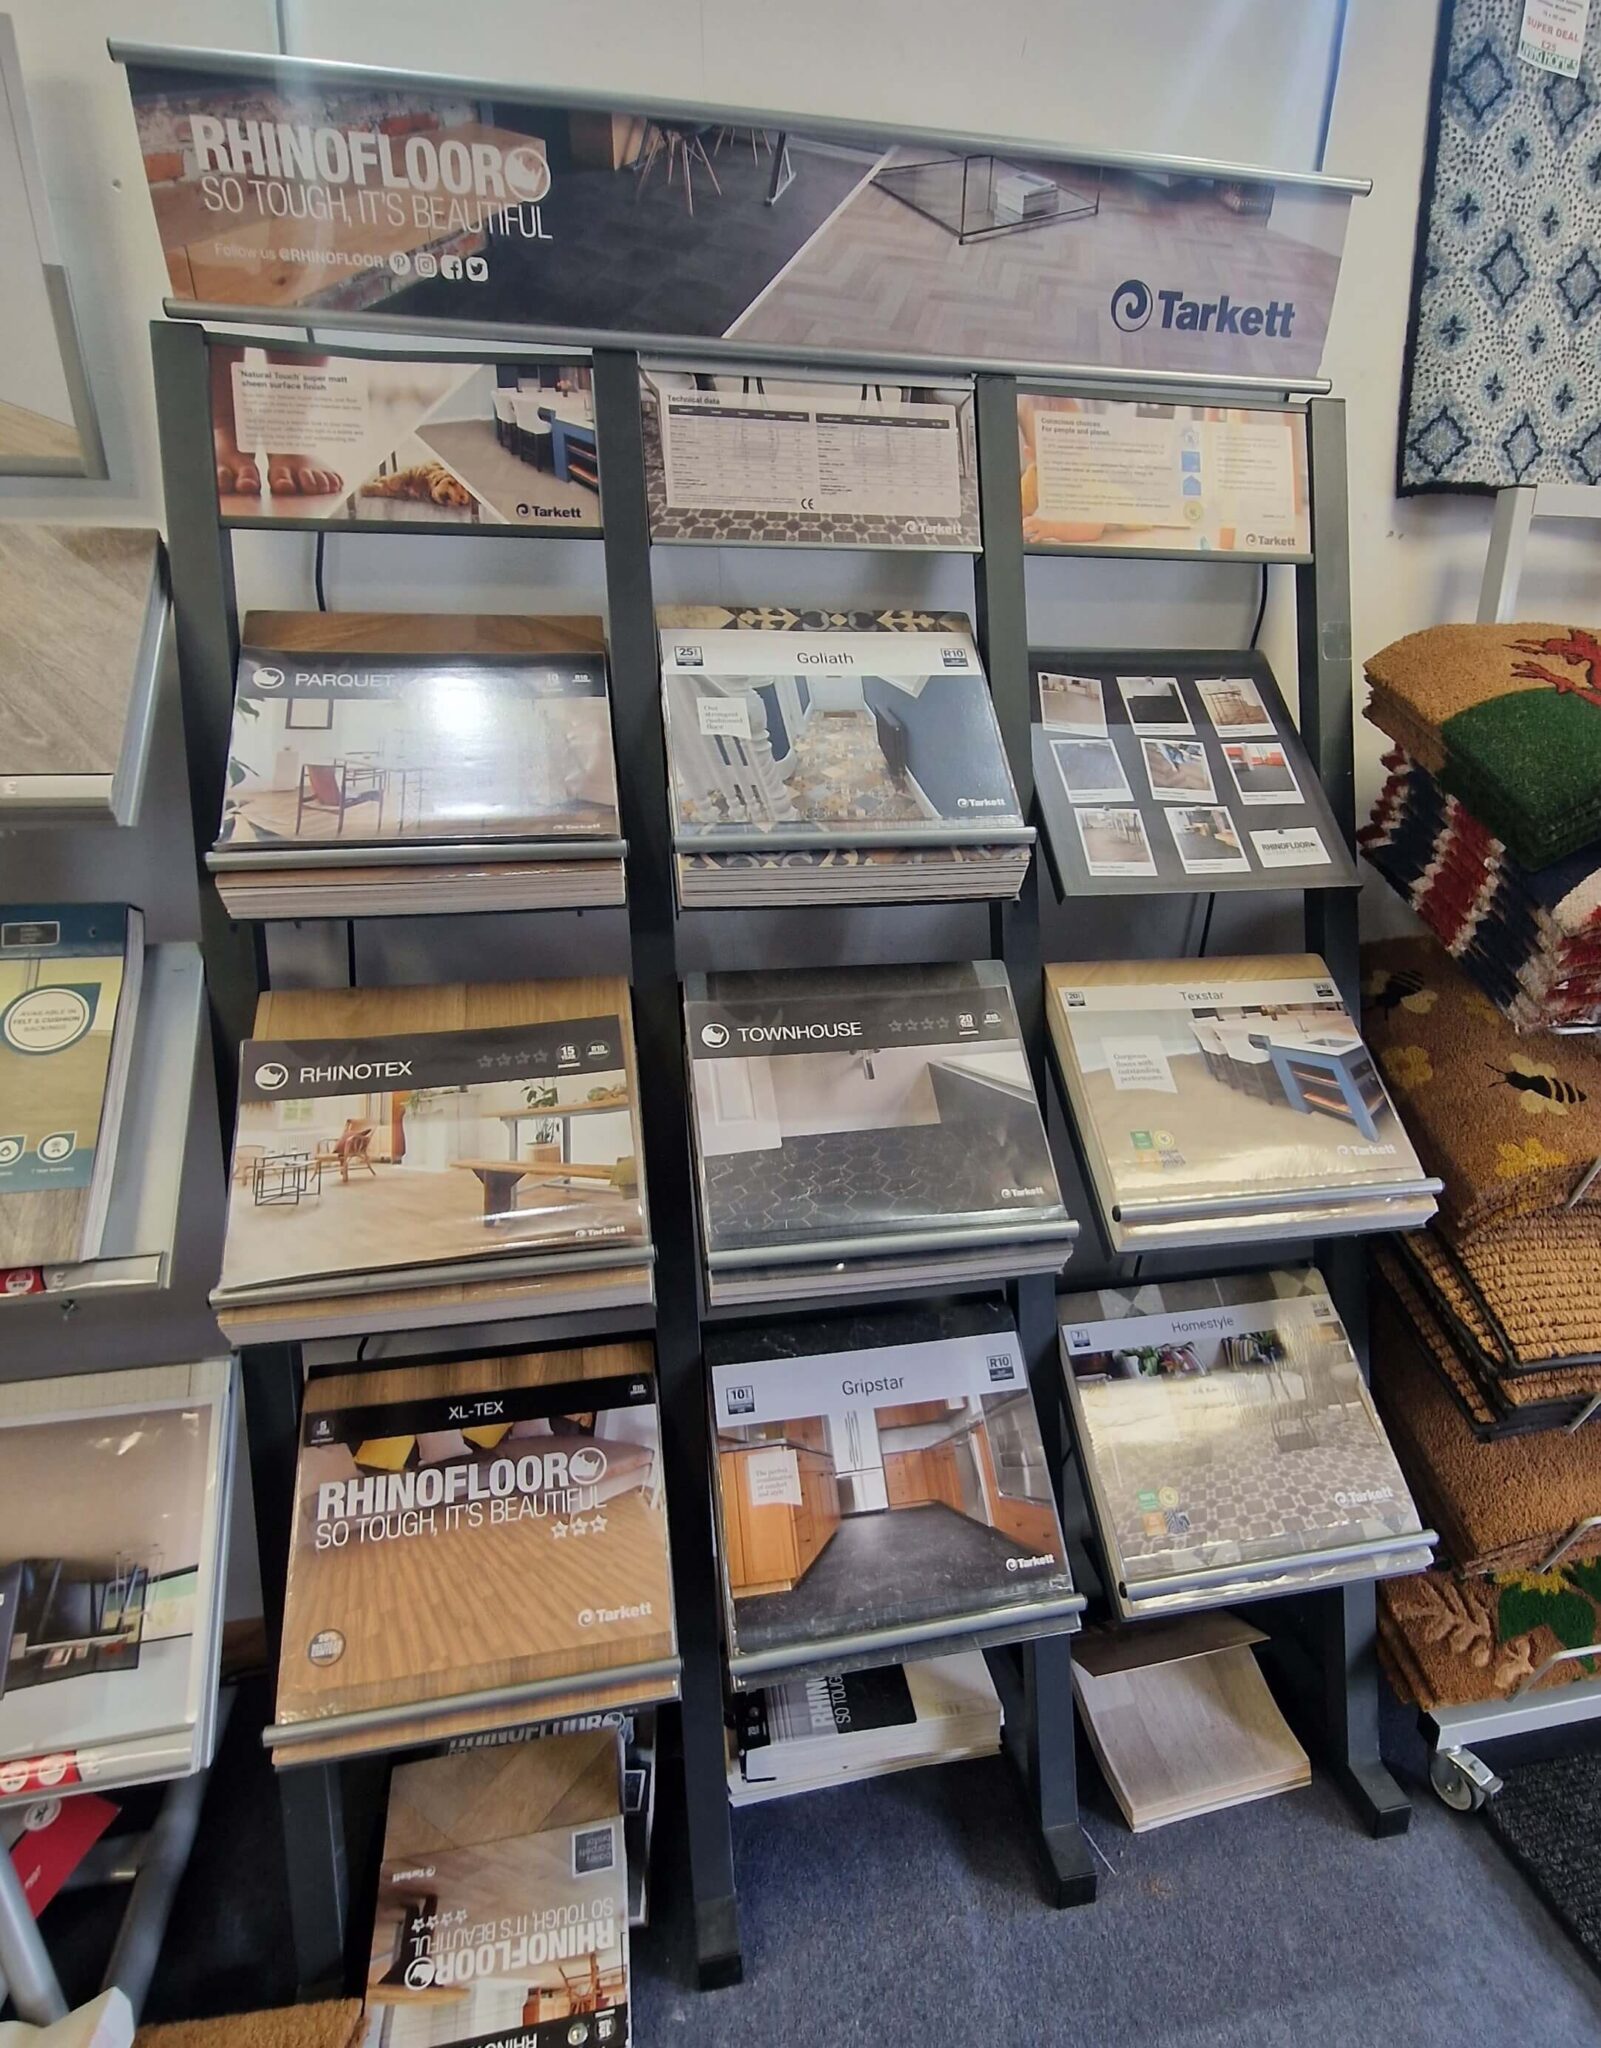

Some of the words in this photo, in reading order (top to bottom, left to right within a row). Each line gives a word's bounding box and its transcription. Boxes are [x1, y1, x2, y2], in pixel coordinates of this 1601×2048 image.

[1527, 16, 1553, 35] SUPER
[1556, 27, 1578, 42] DEAL
[190, 114, 506, 198] RHINOFLOOR
[202, 176, 244, 213] SO
[248, 180, 352, 228] TOUGH,
[358, 190, 405, 226] IT'S
[413, 194, 553, 239] BEAUTIFUL
[215, 243, 257, 258] Follow
[261, 248, 276, 260] us
[279, 247, 384, 268] @RHINOFLOOR
[1158, 290, 1295, 338] Tarkett
[241, 380, 267, 388] sheen
[270, 382, 301, 390] surface
[303, 375, 326, 383] super
[328, 376, 348, 384] matt
[667, 394, 702, 404] Technical
[704, 396, 720, 405] data
[1053, 427, 1075, 436] people
[532, 506, 582, 518] Tarkett
[919, 522, 962, 535] Tarkett
[1258, 535, 1295, 546] Tarkett
[680, 647, 694, 656] 25
[797, 652, 854, 665] Goliath
[943, 650, 964, 658] R10
[295, 673, 396, 687] PARQUET
[969, 799, 1007, 807] Tarkett
[1261, 841, 1311, 850] RHINOFLOOR
[1179, 991, 1225, 1001] Texstar
[959, 1014, 972, 1023] 20
[737, 1022, 863, 1042] TOWNHOUSE
[561, 1045, 576, 1055] 15
[300, 1060, 413, 1083] RHINOTEX
[1350, 1144, 1397, 1156] Tarkett
[1011, 1187, 1044, 1198] Tarkett
[588, 1226, 625, 1236] Tarkett
[1171, 1316, 1235, 1333] Homestyle
[990, 1356, 1009, 1368] R10
[842, 1377, 904, 1396] Gripstar
[732, 1389, 745, 1400] 10
[449, 1400, 505, 1420] XL-TEX
[317, 1452, 570, 1521] RHINOFLOOR
[1347, 1487, 1394, 1505] Tarkett
[315, 1520, 349, 1549] SO
[357, 1511, 438, 1543] TOUGH,
[445, 1502, 483, 1531] IT'S
[490, 1485, 607, 1525] BEAUTIFUL
[1017, 1554, 1055, 1568] Tarkett
[595, 1601, 653, 1623] Tarkett
[829, 1675, 847, 1707] TOUG
[834, 1707, 852, 1724] SO
[392, 1868, 424, 1883] Tarkett
[591, 1897, 614, 1918] SO
[532, 1904, 588, 1929] TOUGH,
[500, 1915, 528, 1938] IT'S
[409, 1921, 496, 1957] BEAUTIFUL
[435, 1918, 615, 1985] RHINOFLOOR
